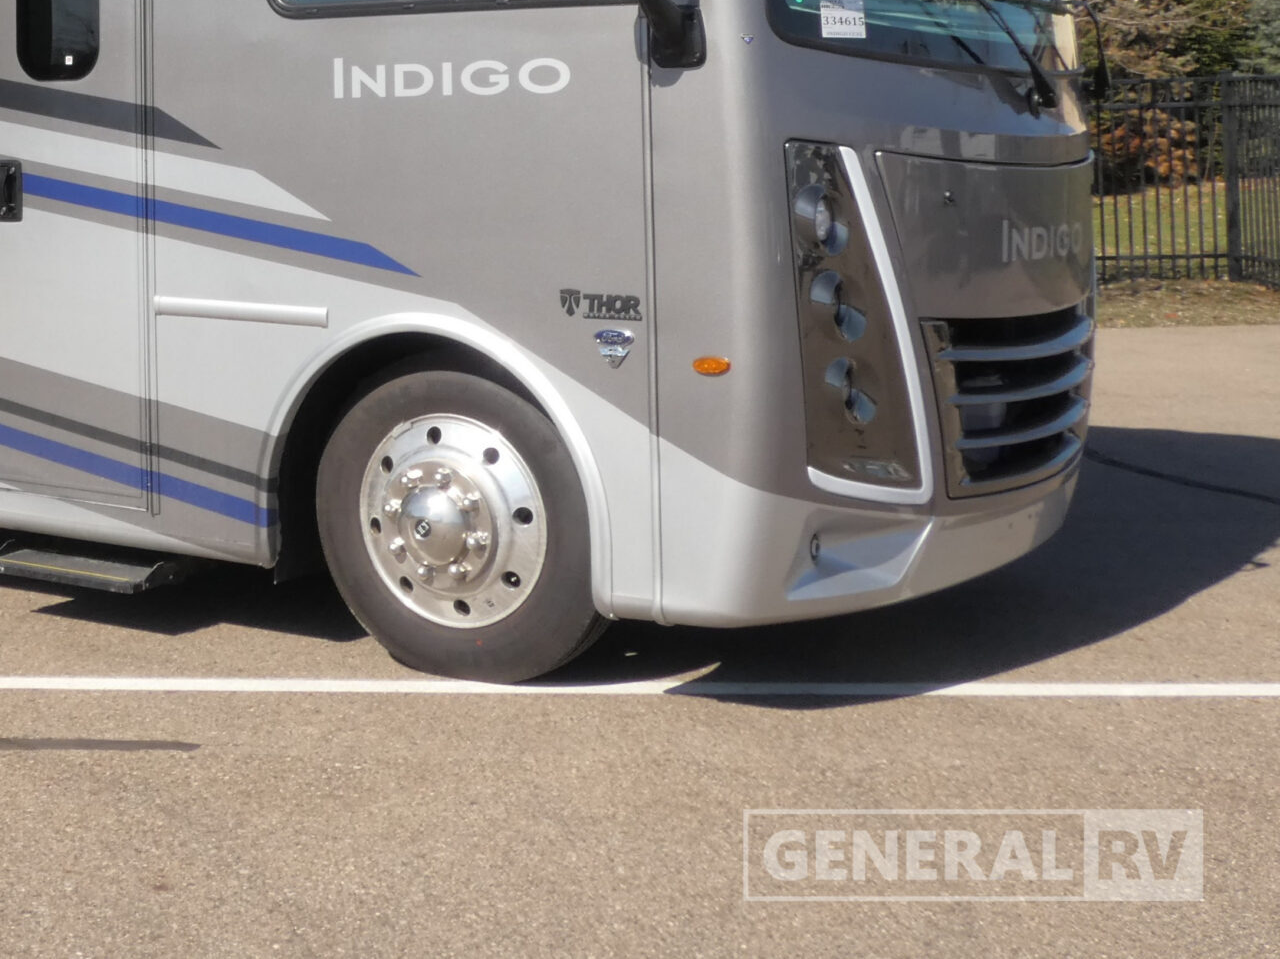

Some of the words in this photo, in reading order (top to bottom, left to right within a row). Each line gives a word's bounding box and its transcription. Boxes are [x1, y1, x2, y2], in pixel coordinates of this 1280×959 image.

[333, 57, 571, 99] INDIGO
[1002, 220, 1083, 262] INDIGO
[583, 293, 641, 315] THOR
